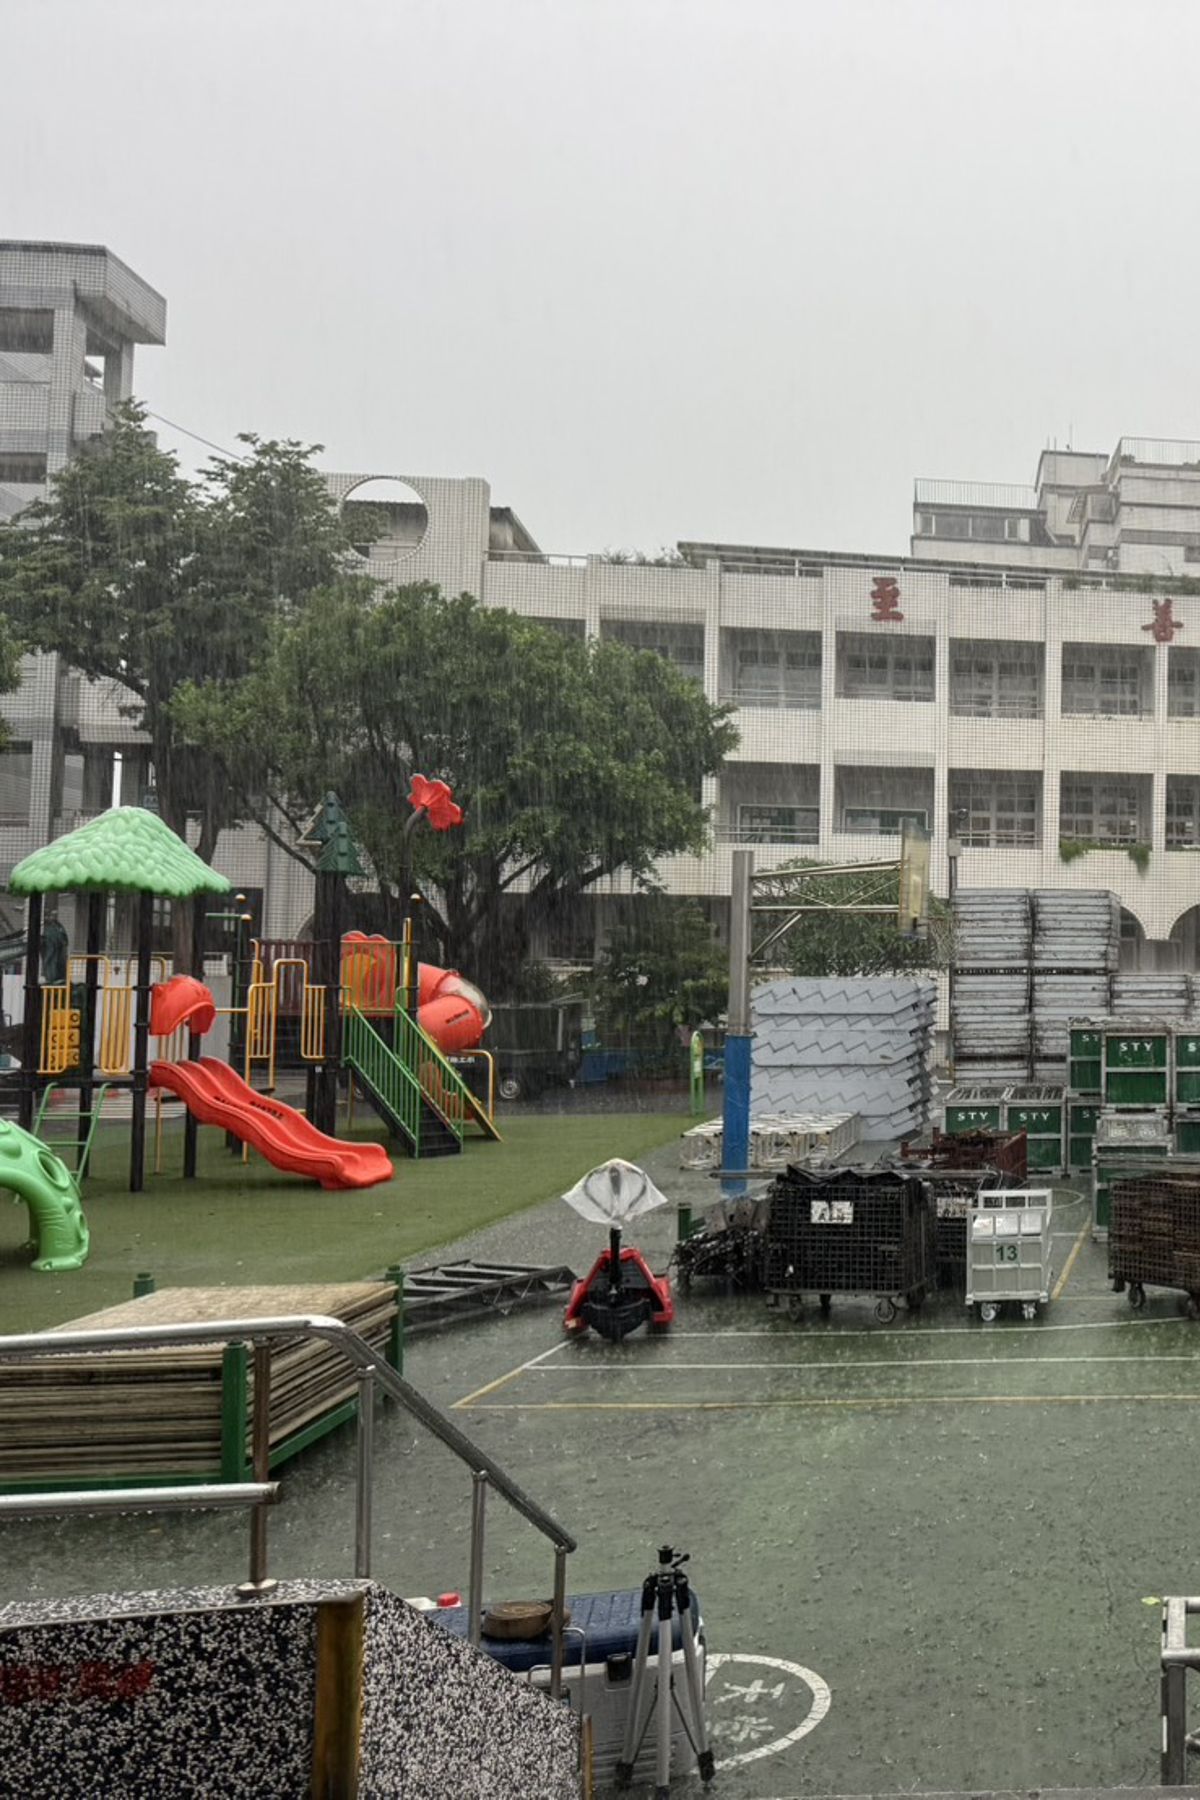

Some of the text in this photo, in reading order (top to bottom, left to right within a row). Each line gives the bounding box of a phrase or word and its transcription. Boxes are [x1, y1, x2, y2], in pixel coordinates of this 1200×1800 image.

[1141, 598, 1184, 642] 善
[1120, 1042, 1153, 1052] STY
[957, 1111, 989, 1121] STY
[1019, 1111, 1050, 1121] STY
[996, 1245, 1018, 1261] 13
